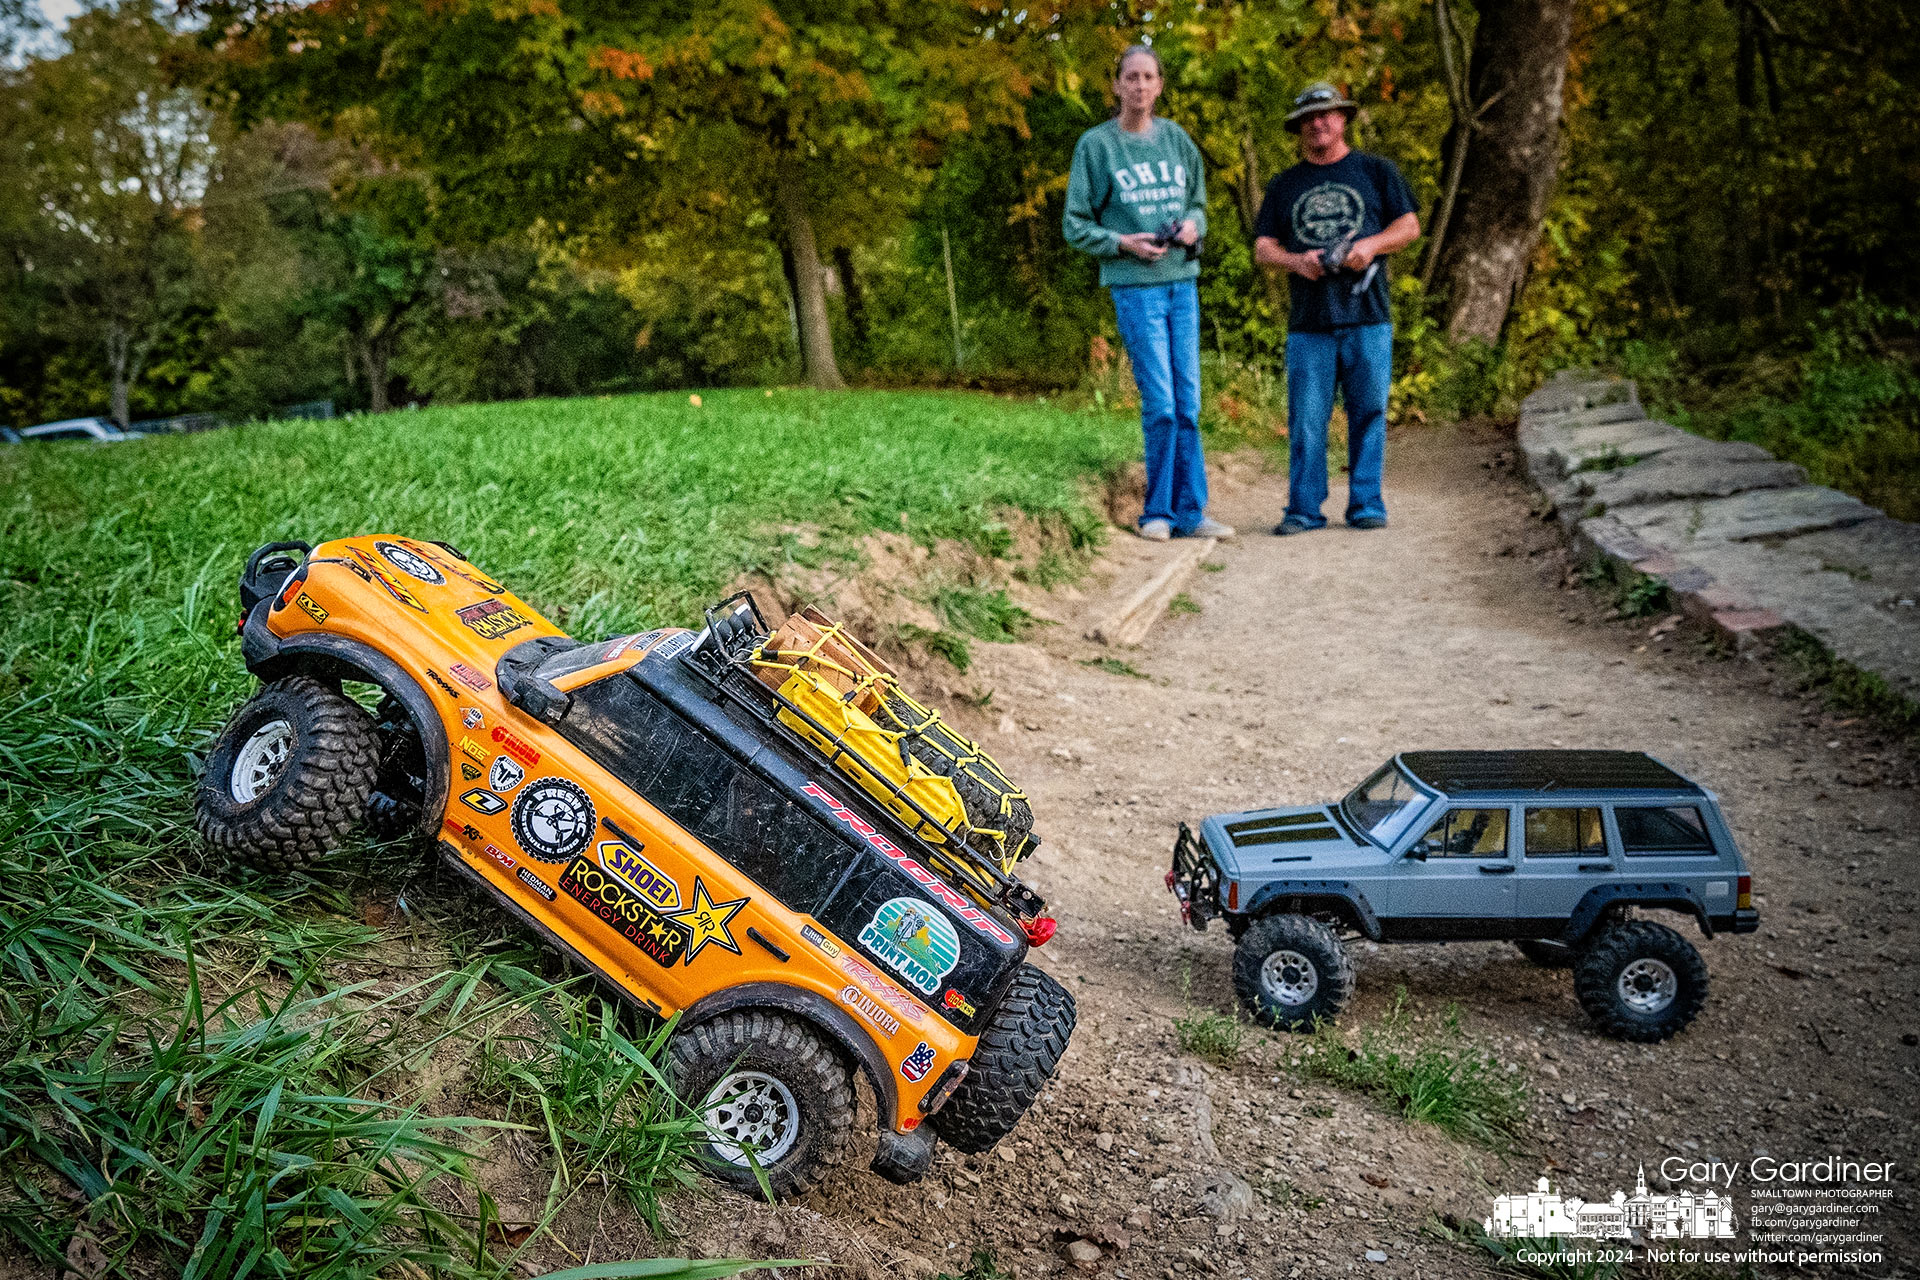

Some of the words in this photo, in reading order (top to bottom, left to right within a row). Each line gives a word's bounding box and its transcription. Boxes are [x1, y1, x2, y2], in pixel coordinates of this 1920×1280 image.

[459, 735, 491, 761] NOS
[533, 788, 583, 811] FRESH
[576, 811, 587, 838] RC
[556, 838, 580, 854] OHIO
[520, 868, 554, 896] HEDMAN
[608, 848, 672, 905] SHOEI
[562, 876, 622, 926] ENERGY
[624, 924, 671, 963] DRINK
[803, 926, 822, 945] Little
[822, 940, 838, 958] Guy
[861, 926, 906, 967] PRINT
[904, 959, 938, 993] MOB
[856, 993, 901, 1036] INJORA
